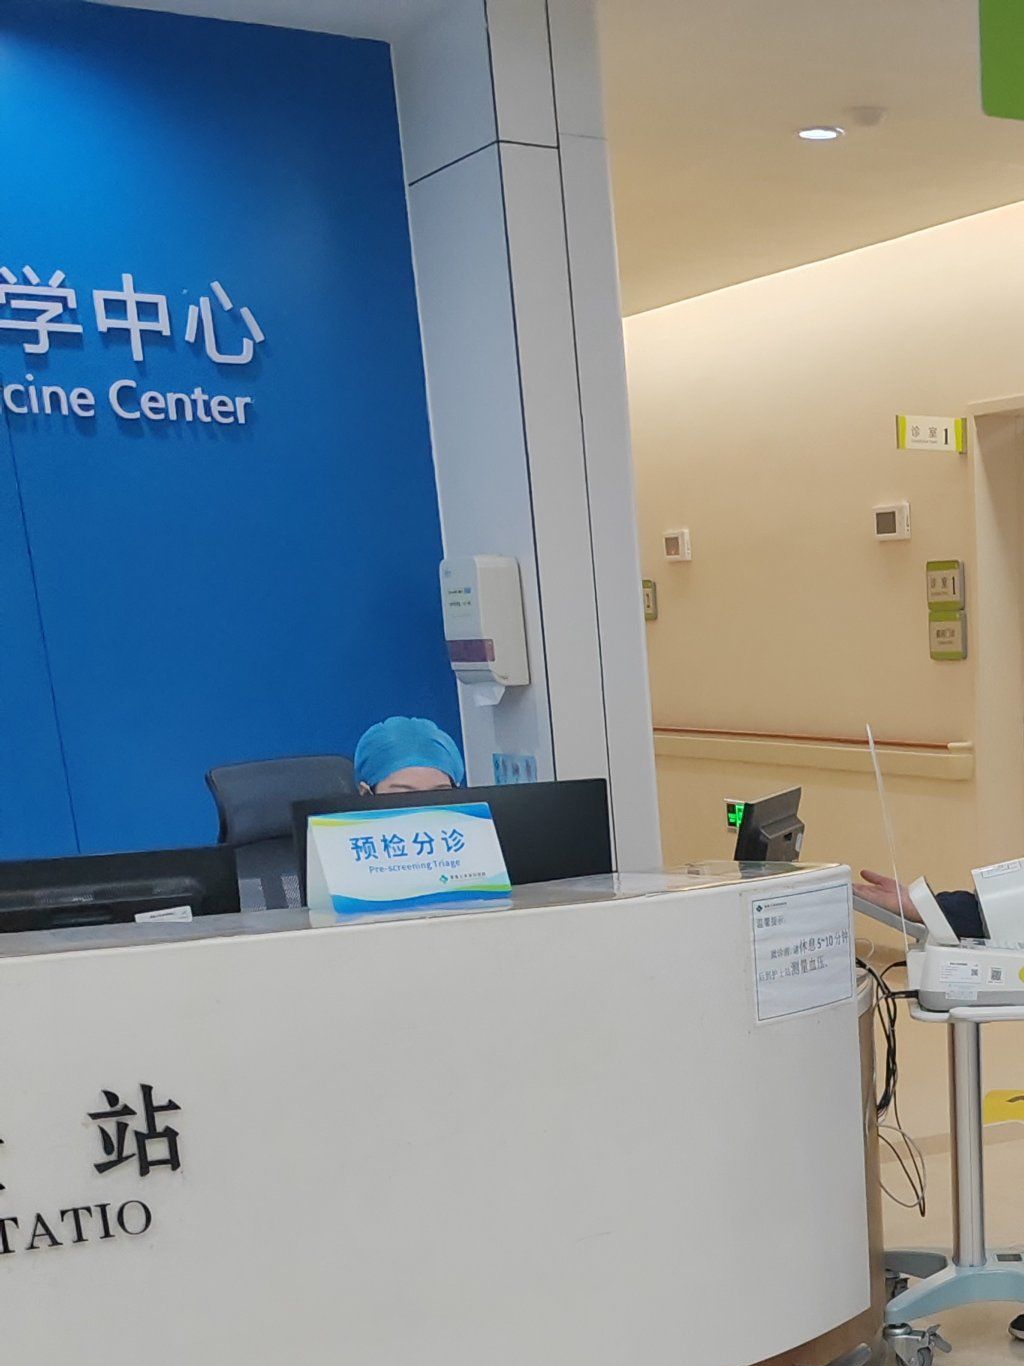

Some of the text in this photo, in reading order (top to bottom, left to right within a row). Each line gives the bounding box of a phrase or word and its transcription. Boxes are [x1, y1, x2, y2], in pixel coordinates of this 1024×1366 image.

[0, 264, 266, 365] 学中心
[0, 373, 252, 425] cine Center
[349, 828, 466, 862] 预检分诊
[368, 858, 461, 874] Pre-screening Triage
